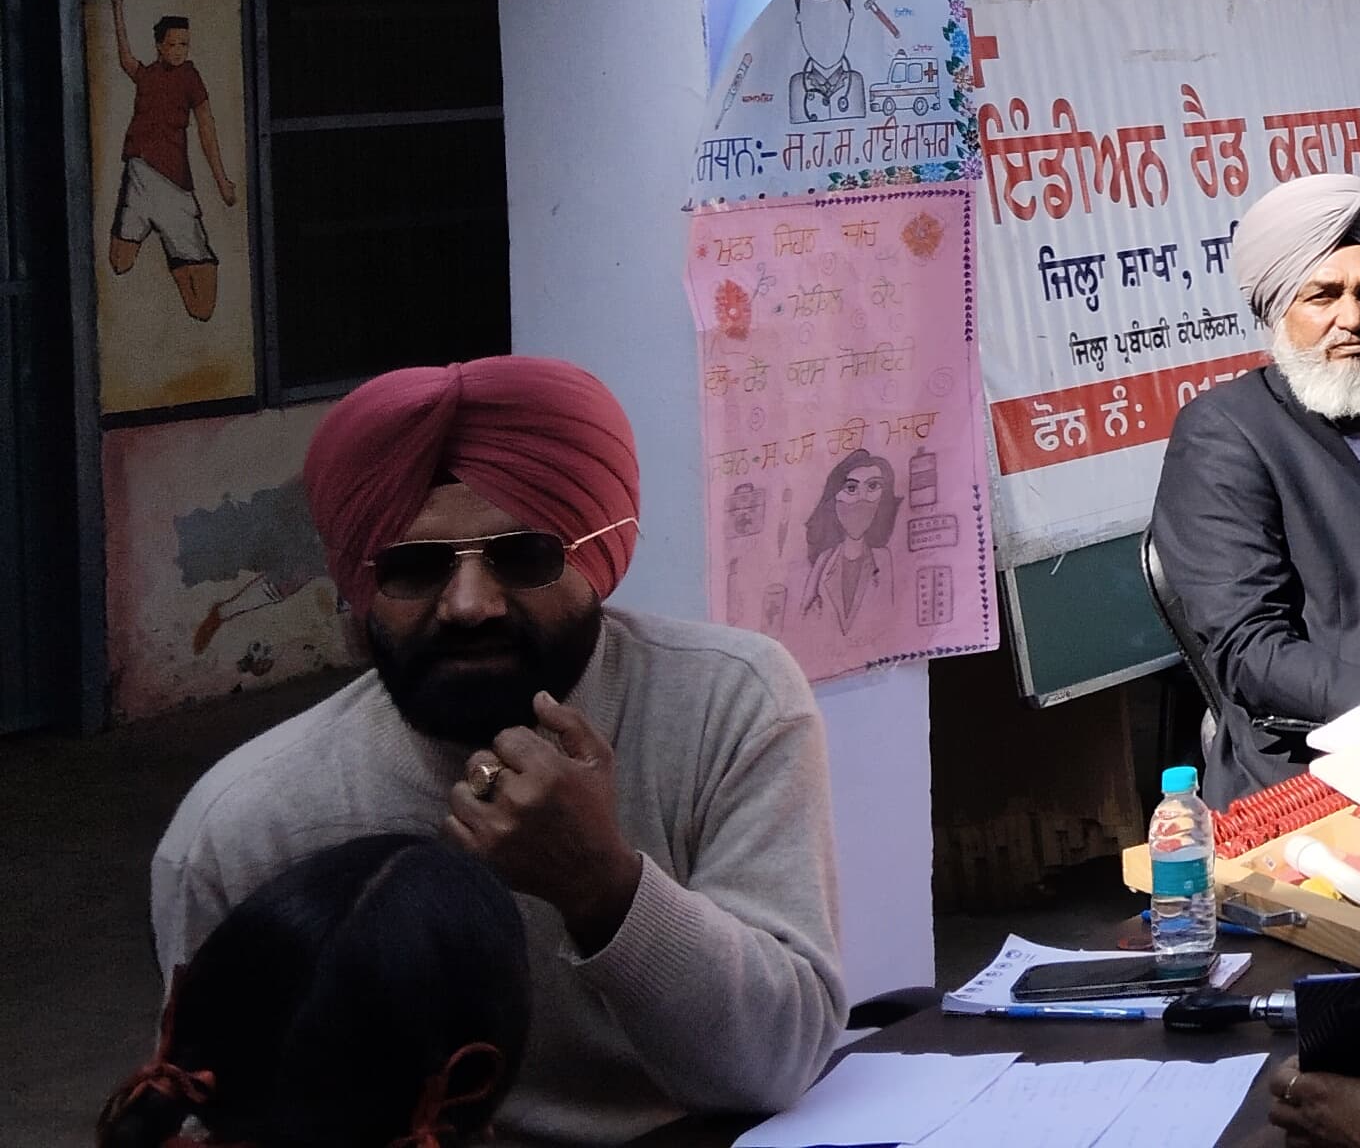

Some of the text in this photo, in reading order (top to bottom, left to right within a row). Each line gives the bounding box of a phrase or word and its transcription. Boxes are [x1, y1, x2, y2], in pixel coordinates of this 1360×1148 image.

[977, 96, 1167, 225] ਇੰਡੀਅਨ
[1180, 82, 1250, 200] ਰੈਡ
[1037, 244, 1106, 313] ਜਿਲ੍ਹਾ
[1030, 400, 1088, 452] ਫੋਨ
